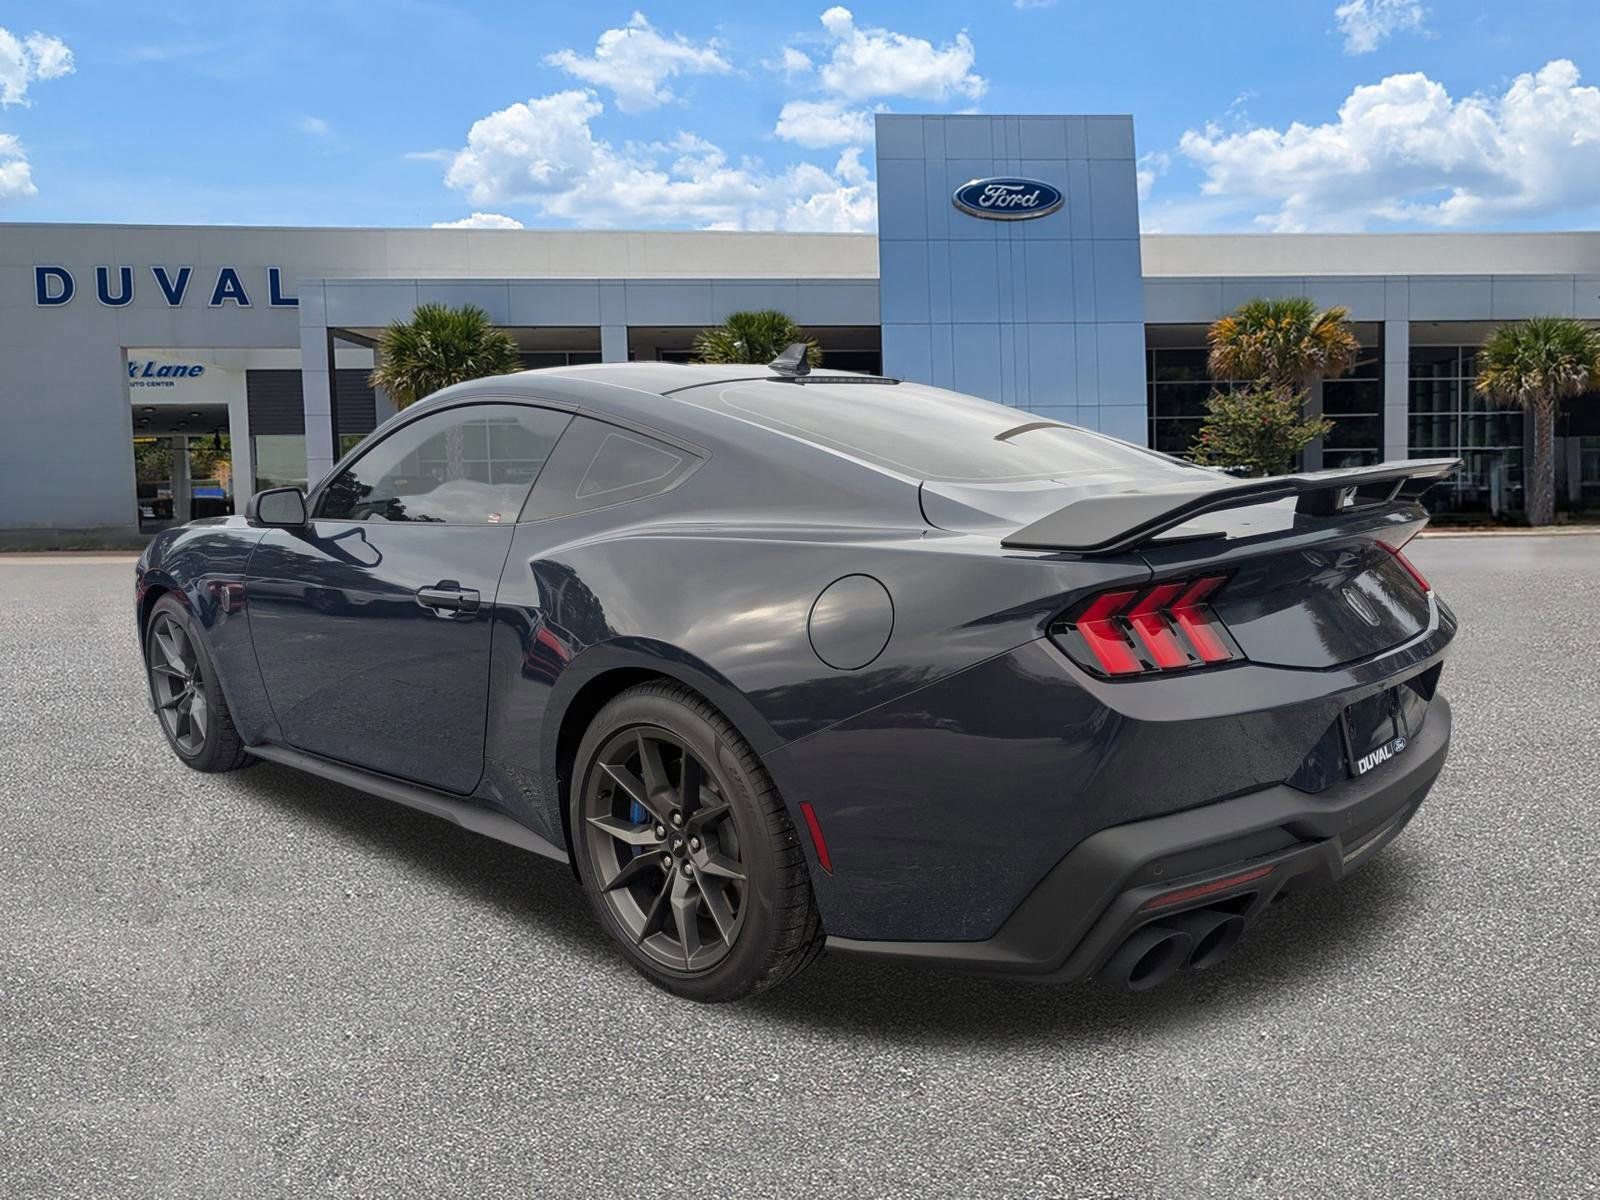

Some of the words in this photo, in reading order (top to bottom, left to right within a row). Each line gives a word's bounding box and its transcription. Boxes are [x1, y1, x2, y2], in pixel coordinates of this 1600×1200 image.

[978, 184, 1041, 207] Ford
[34, 266, 300, 308] DUVAL
[141, 361, 203, 378] Lane
[1358, 745, 1393, 775] DUVAL
